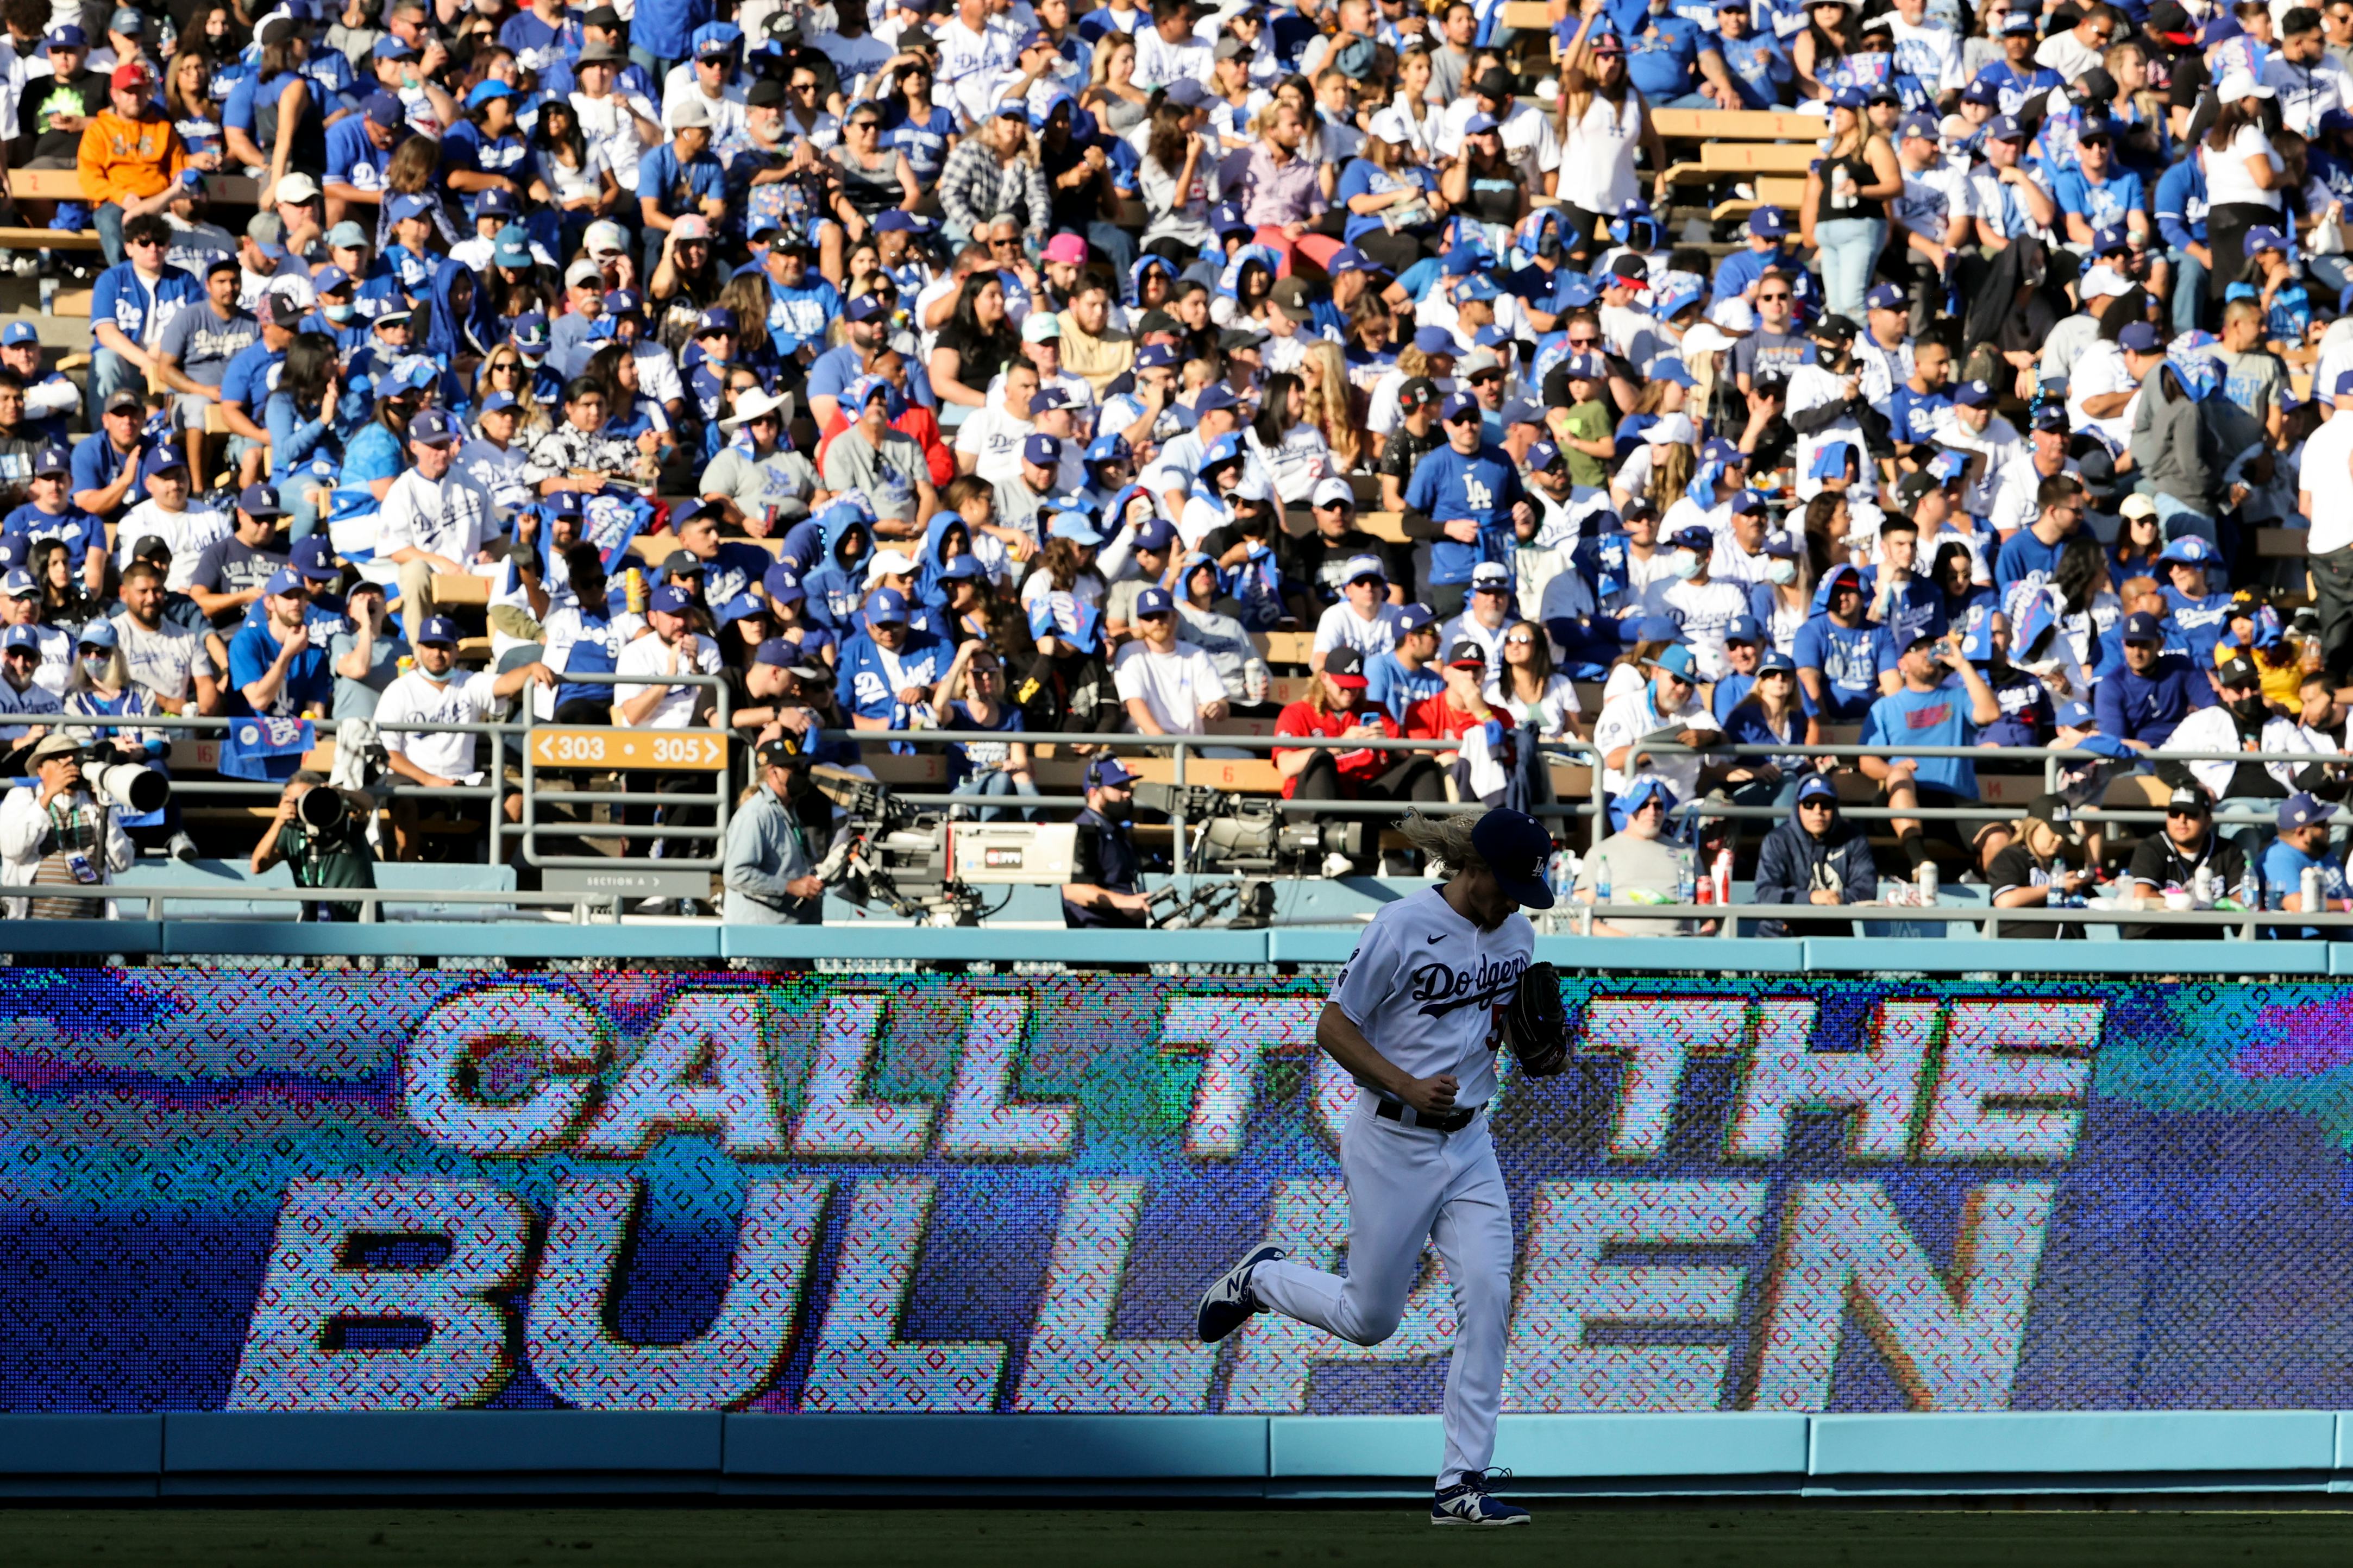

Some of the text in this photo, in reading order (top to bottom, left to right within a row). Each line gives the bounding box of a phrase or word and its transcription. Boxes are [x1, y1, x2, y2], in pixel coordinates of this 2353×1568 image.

[194, 330, 254, 357] Dodgers
[1462, 473, 1492, 510] LA
[413, 496, 481, 543] Dodgers
[1666, 607, 1733, 632] Dodgers
[1278, 684, 1289, 701] 8
[197, 745, 213, 763] 16
[558, 736, 700, 763] 303 305
[1222, 766, 1234, 783] 6
[1532, 857, 1545, 877] LA
[587, 876, 645, 886] SECTION A
[1413, 954, 1527, 1019] Dodgers
[403, 985, 2105, 1157] CALL T THE
[227, 1177, 2057, 1412] BULLPEN
